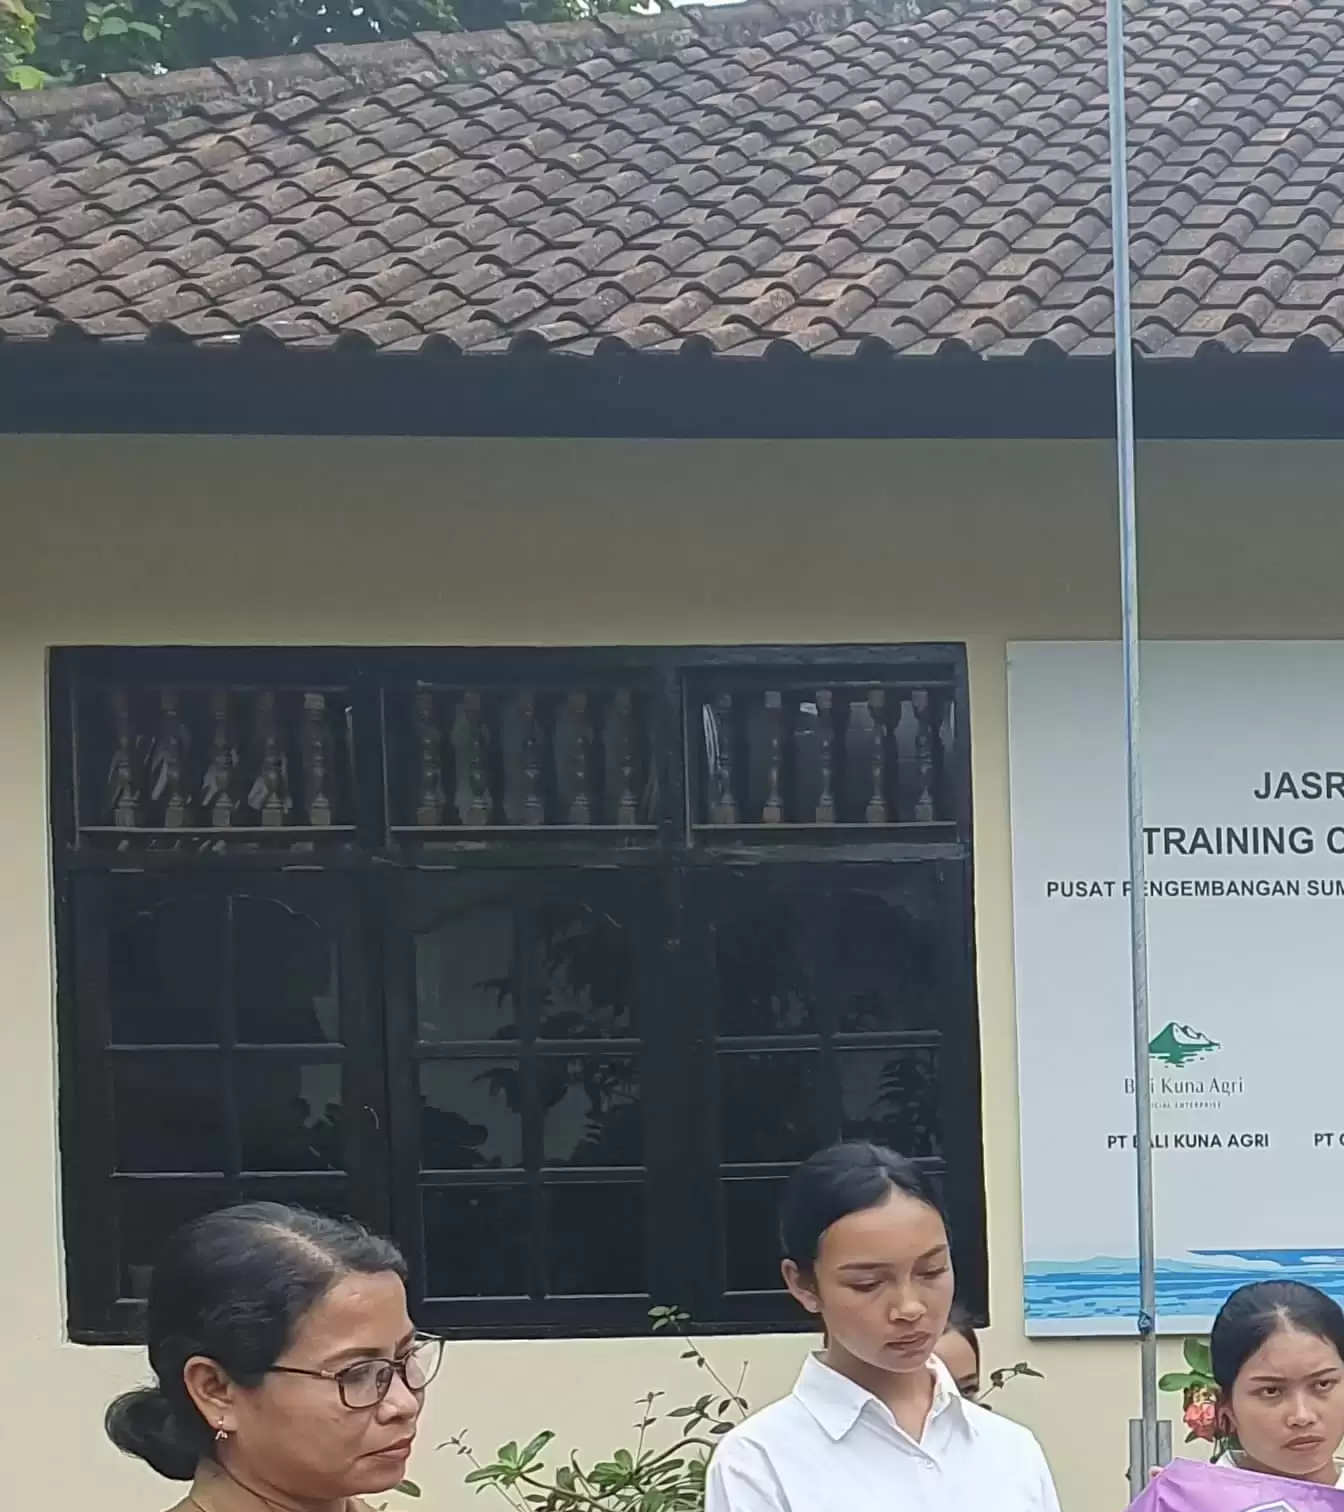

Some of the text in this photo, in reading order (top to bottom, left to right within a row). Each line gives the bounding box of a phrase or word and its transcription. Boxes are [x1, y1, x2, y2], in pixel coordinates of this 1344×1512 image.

[1143, 826, 1315, 854] TRAINING
[1047, 881, 1116, 897] PUSAT
[1124, 1076, 1243, 1096] Bi Kuna Agri
[1107, 1135, 1128, 1149] PT
[1174, 1134, 1222, 1149] KUNA
[1227, 1133, 1270, 1149] AGRI
[1314, 1132, 1335, 1147] PT
